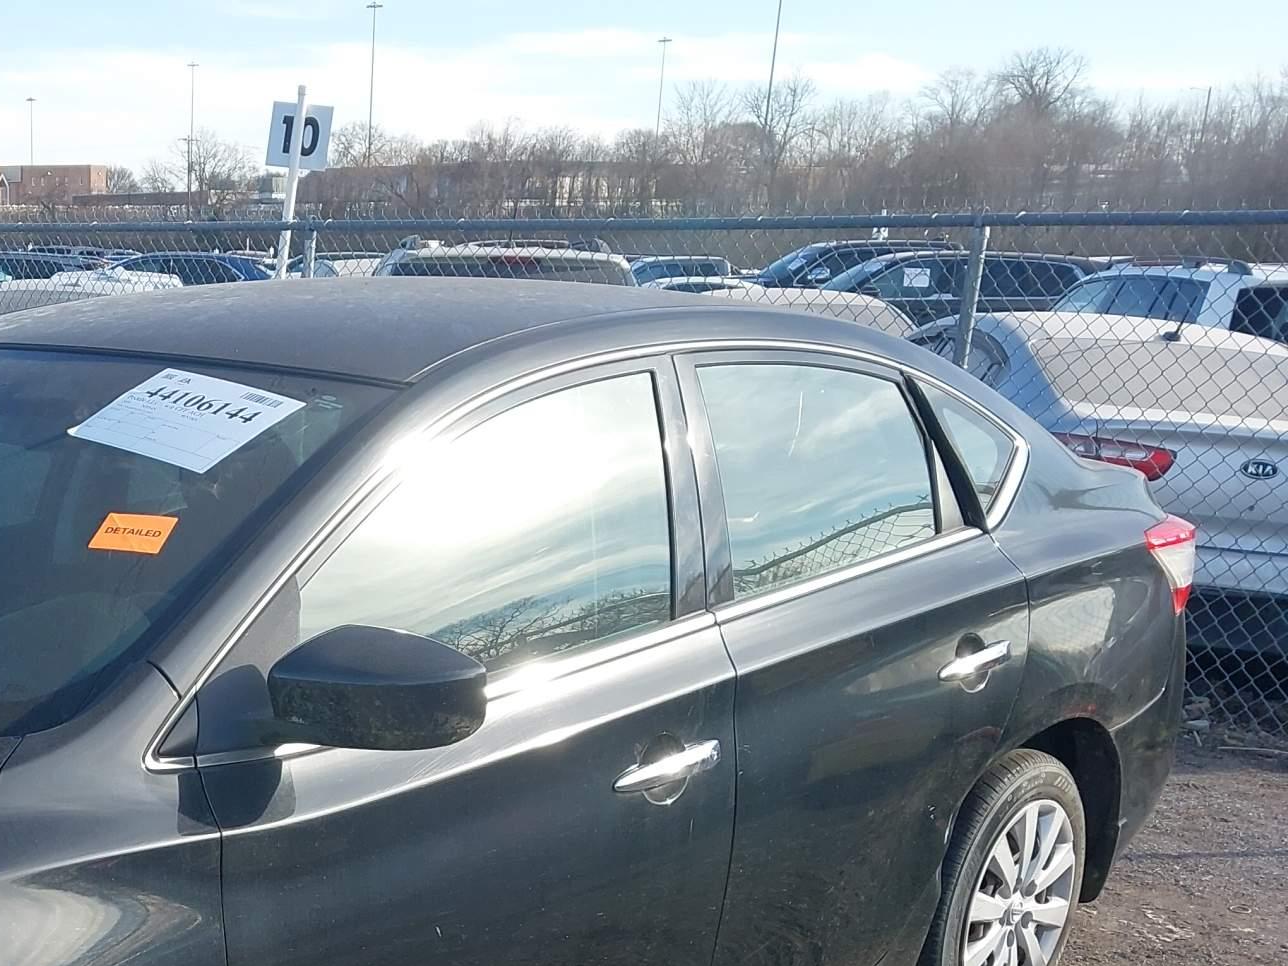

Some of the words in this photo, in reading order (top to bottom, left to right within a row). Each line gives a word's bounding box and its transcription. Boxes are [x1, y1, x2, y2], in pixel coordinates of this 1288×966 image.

[282, 115, 320, 157] 10
[146, 386, 262, 424] 44106144
[1247, 463, 1273, 475] KIA
[104, 526, 162, 538] DETAILED
